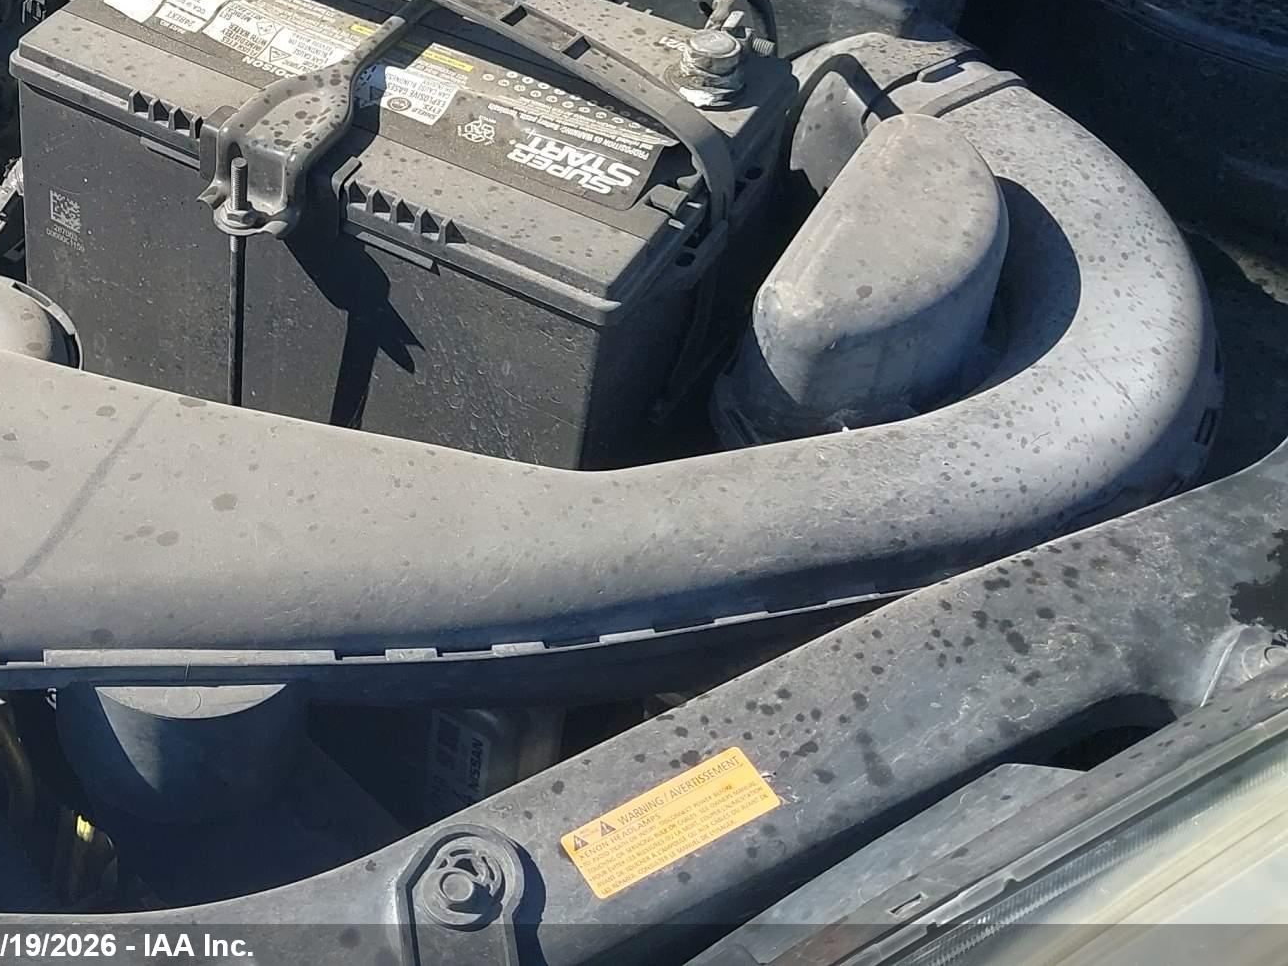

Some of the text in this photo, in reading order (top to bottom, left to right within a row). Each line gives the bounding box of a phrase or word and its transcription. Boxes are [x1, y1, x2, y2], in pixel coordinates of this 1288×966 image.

[220, 26, 263, 52] IMMEDIATELY
[227, 21, 268, 46] WITH WATER
[241, 55, 296, 79] POISON
[385, 81, 446, 109] EXPLOSIVE GASES
[593, 135, 603, 144] 65
[602, 137, 649, 160] PROPOSITION
[507, 149, 613, 195] SUPER
[523, 133, 641, 189] START
[468, 737, 485, 793] NISSAN
[617, 795, 665, 827] WARNING
[668, 755, 740, 800] AVERTISSEMENT
[609, 811, 661, 844] HEADLAMPS
